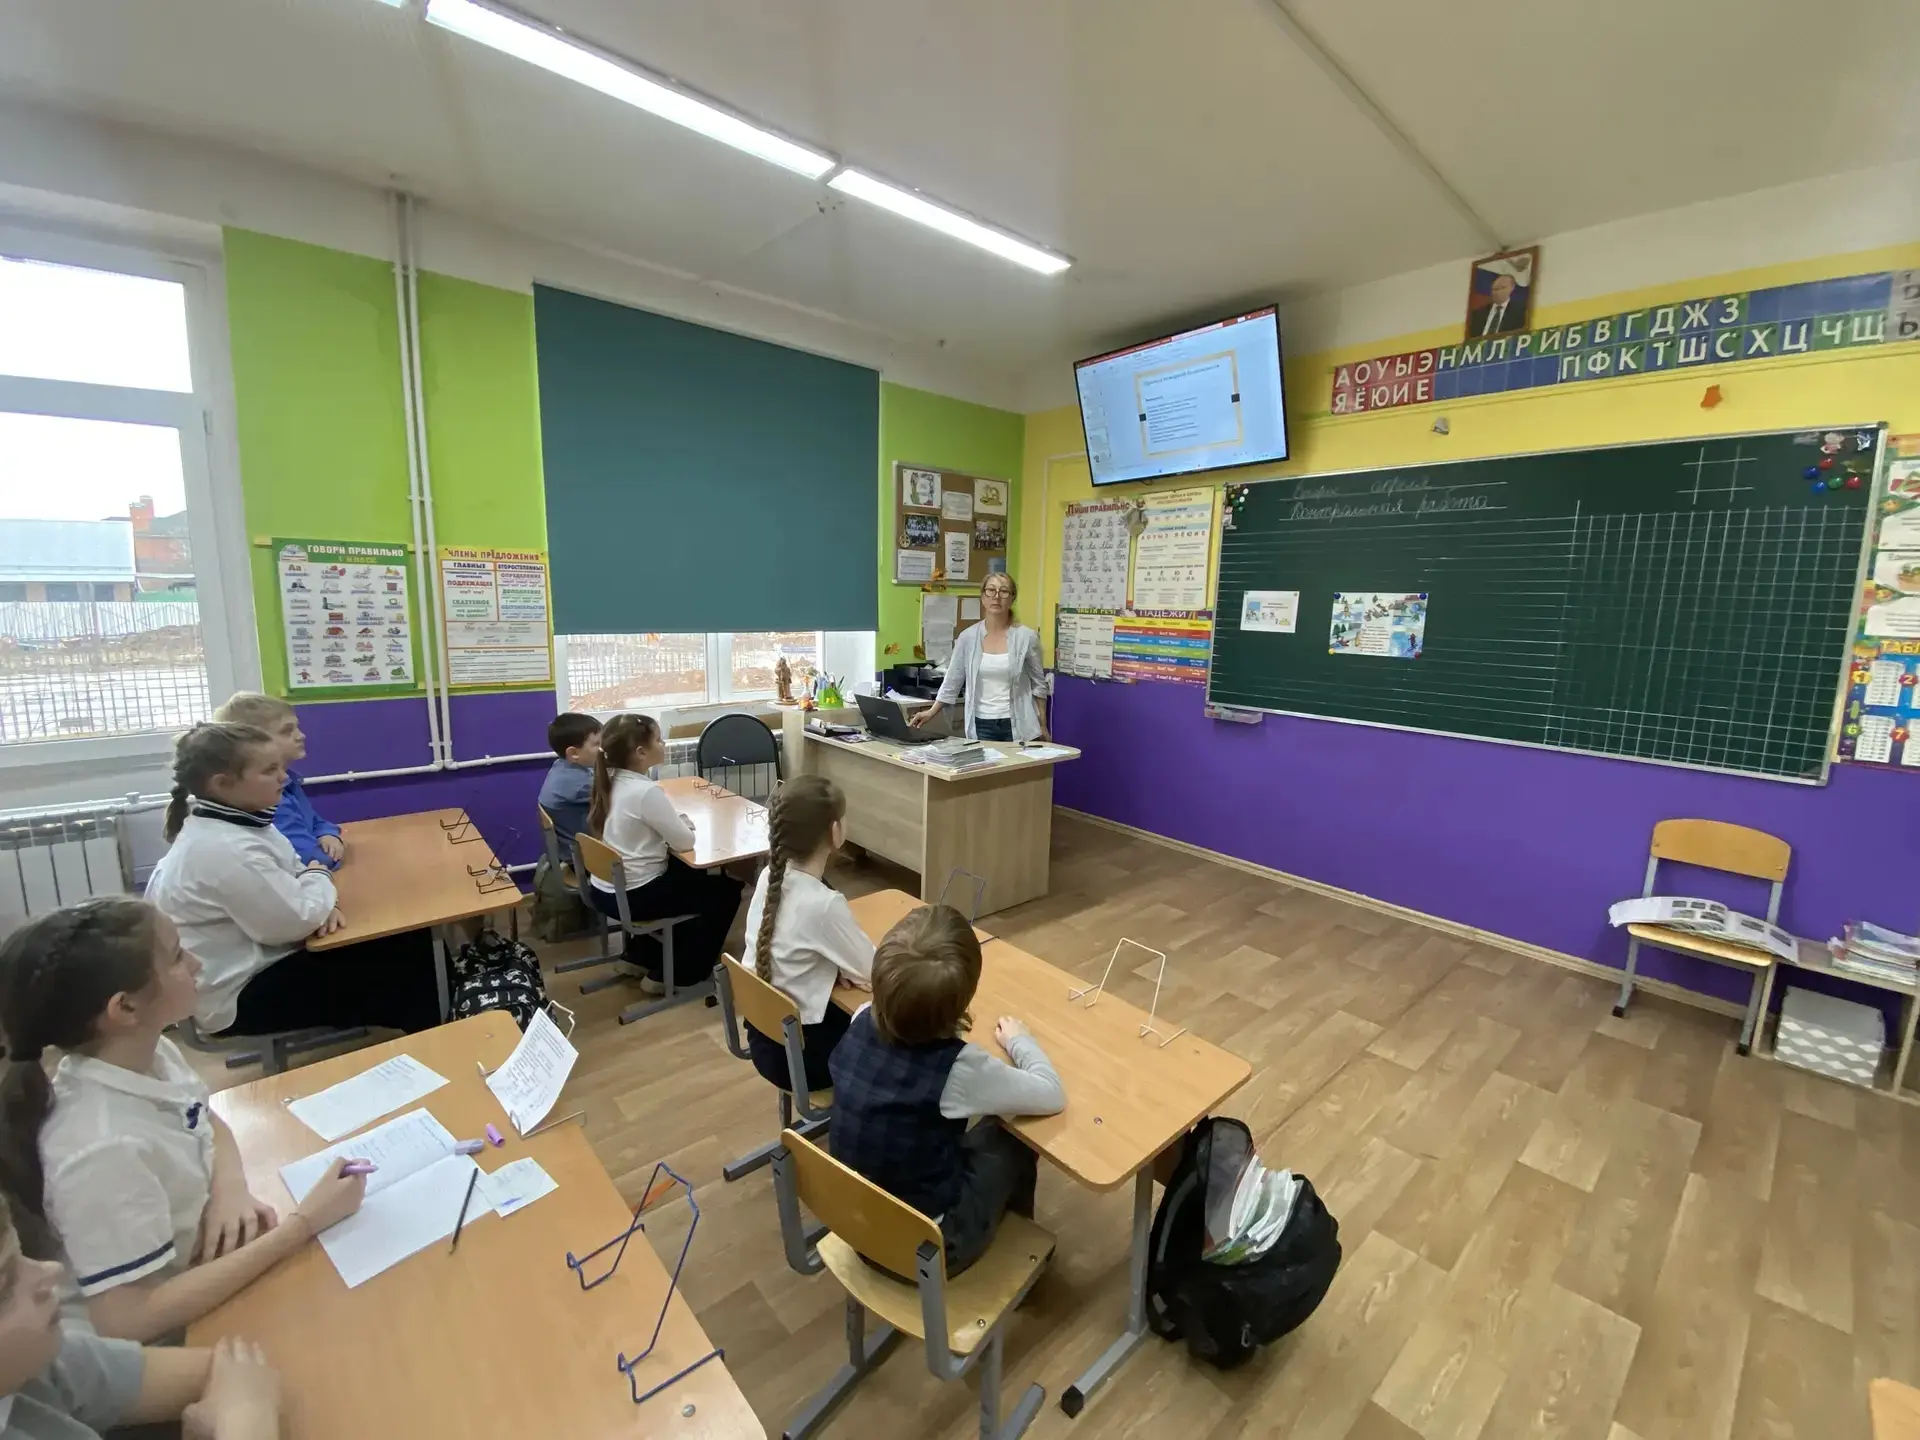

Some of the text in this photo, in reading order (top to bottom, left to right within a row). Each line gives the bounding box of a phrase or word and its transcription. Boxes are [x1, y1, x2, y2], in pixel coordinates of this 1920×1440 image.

[307, 544, 404, 557] ГОВОРИ ПРАВИЛЬНО
[448, 549, 540, 561] ЧЛЕНЫ ПРЕДЛОЖЕНИЯ
